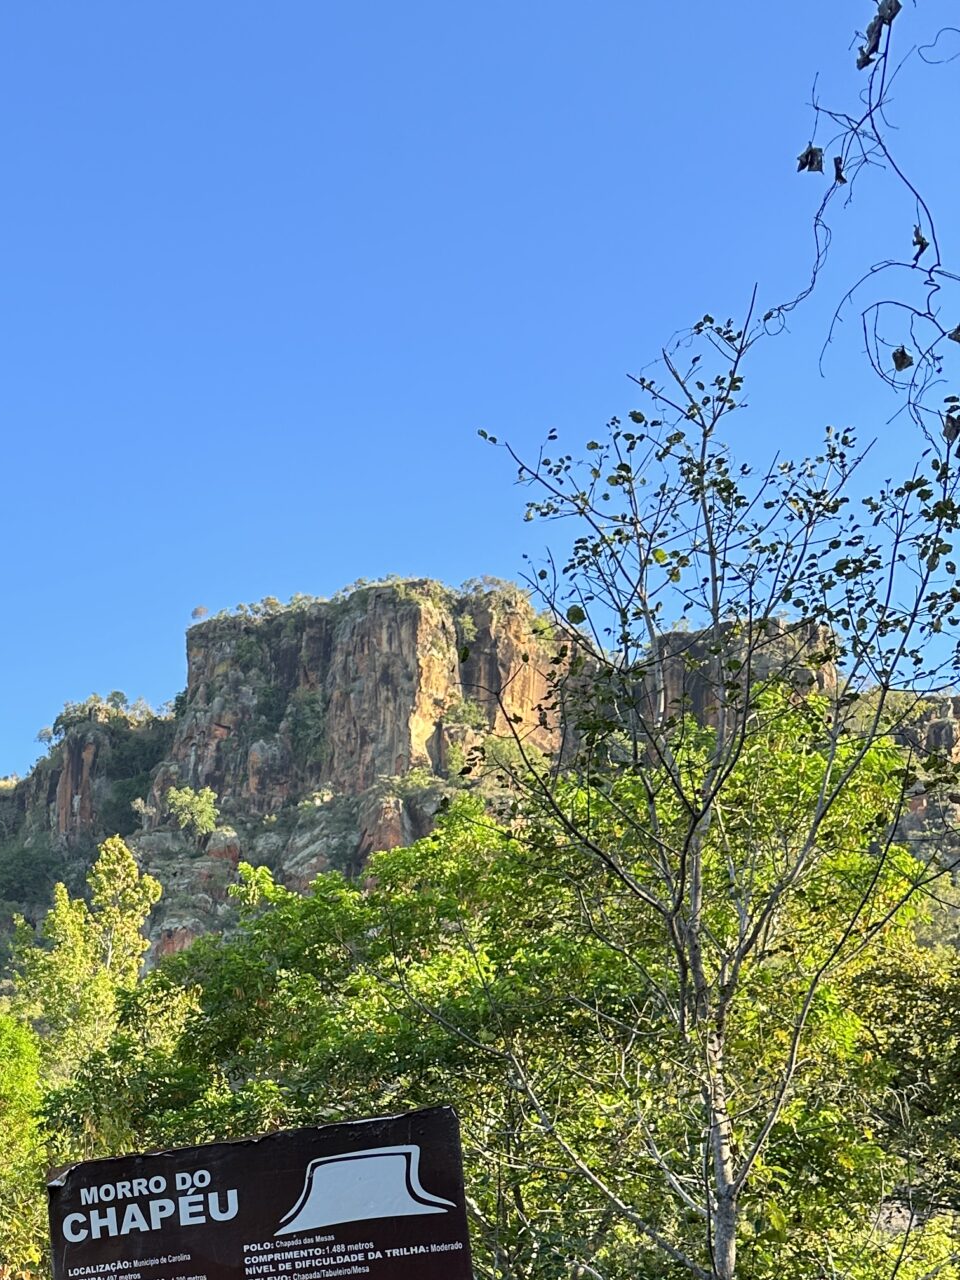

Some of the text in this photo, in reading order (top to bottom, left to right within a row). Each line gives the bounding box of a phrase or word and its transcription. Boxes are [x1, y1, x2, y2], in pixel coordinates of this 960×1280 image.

[80, 1170, 211, 1206] MORRO DO
[62, 1187, 238, 1242] CHAPÉU
[243, 1242, 274, 1252] POLO:
[275, 1238, 302, 1248] Chapada
[315, 1234, 334, 1242] Mesas
[347, 1242, 374, 1251] metros
[68, 1260, 132, 1276] LOCALIZAÇÃO:
[168, 1253, 190, 1262] Carolina
[245, 1241, 462, 1275] NÍVEL DE DIFICULDADE DA TRILHA: Moderado
